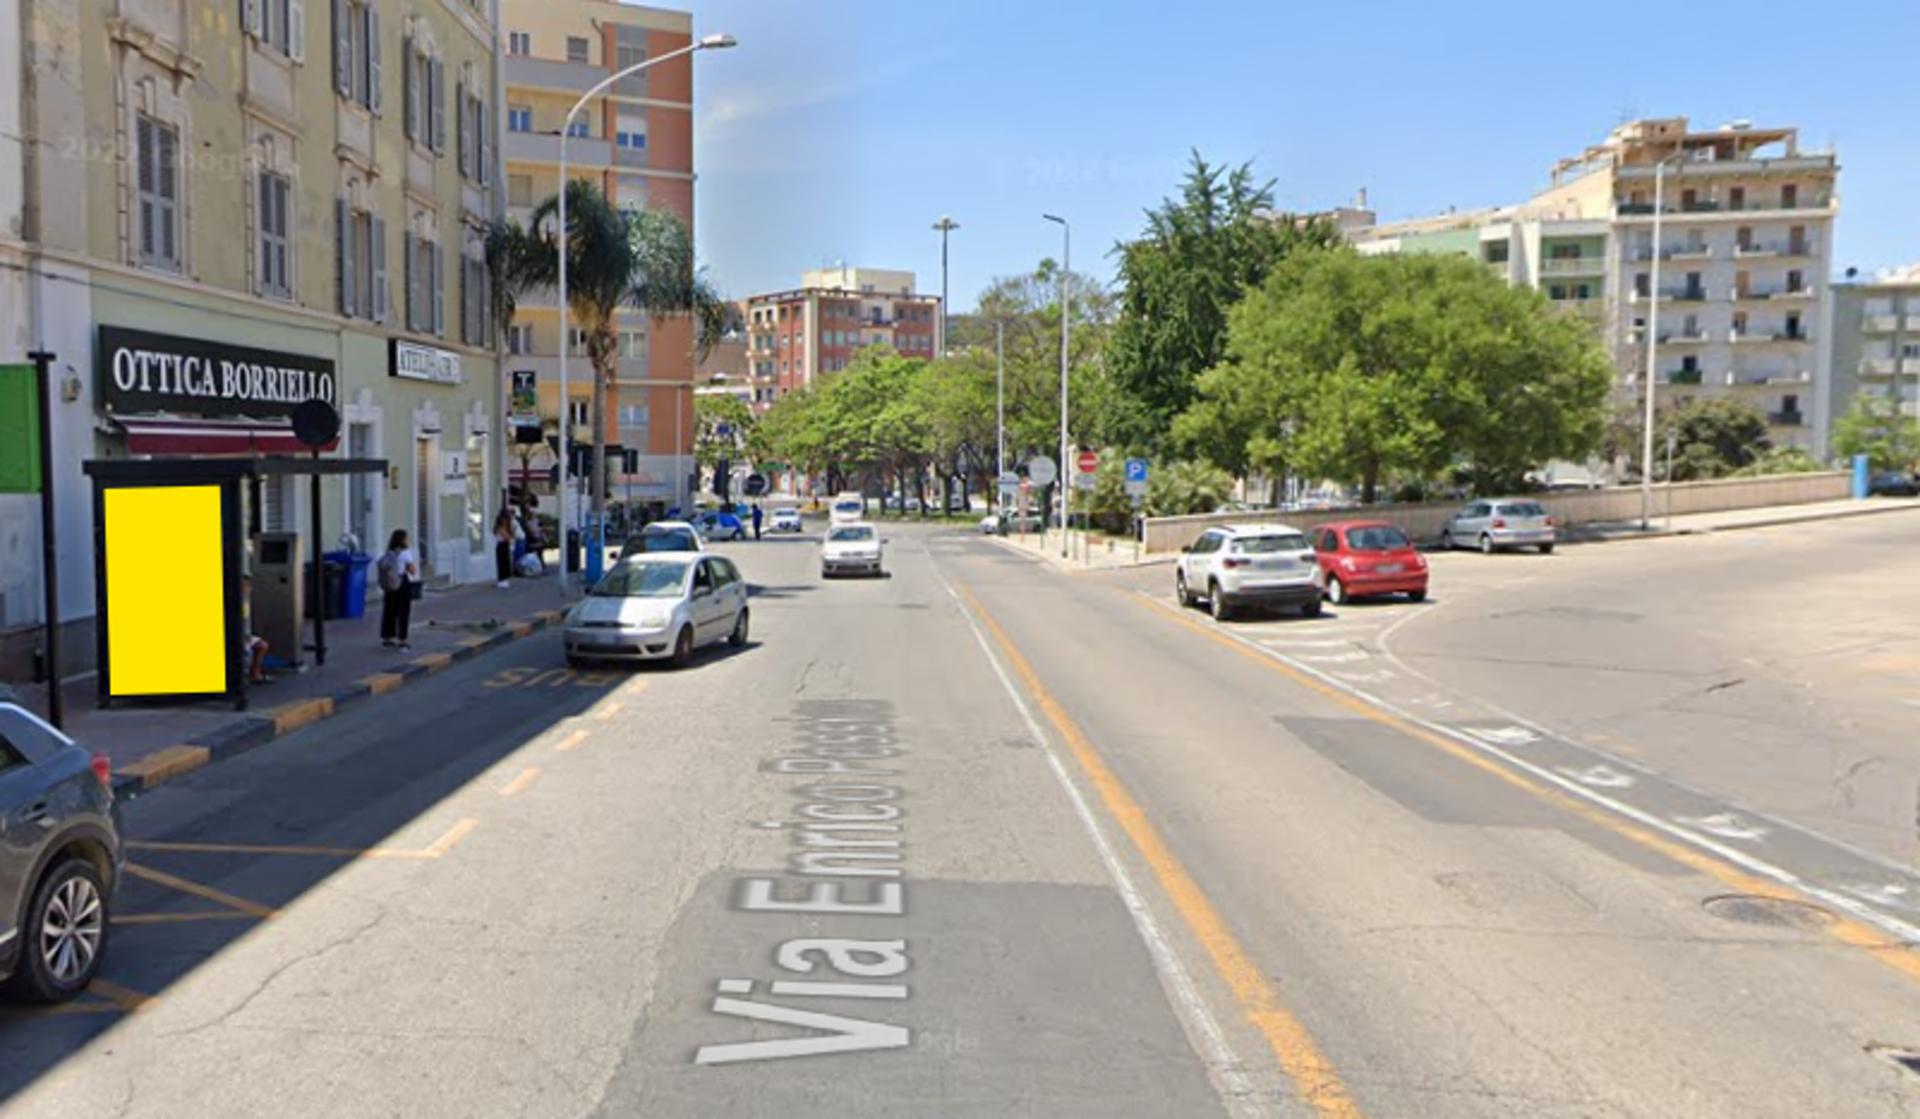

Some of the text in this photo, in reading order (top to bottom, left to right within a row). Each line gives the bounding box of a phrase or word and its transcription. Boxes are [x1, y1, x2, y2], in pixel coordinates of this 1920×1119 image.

[113, 347, 333, 403] OTTICA BORRIELLO
[1129, 461, 1142, 478] P
